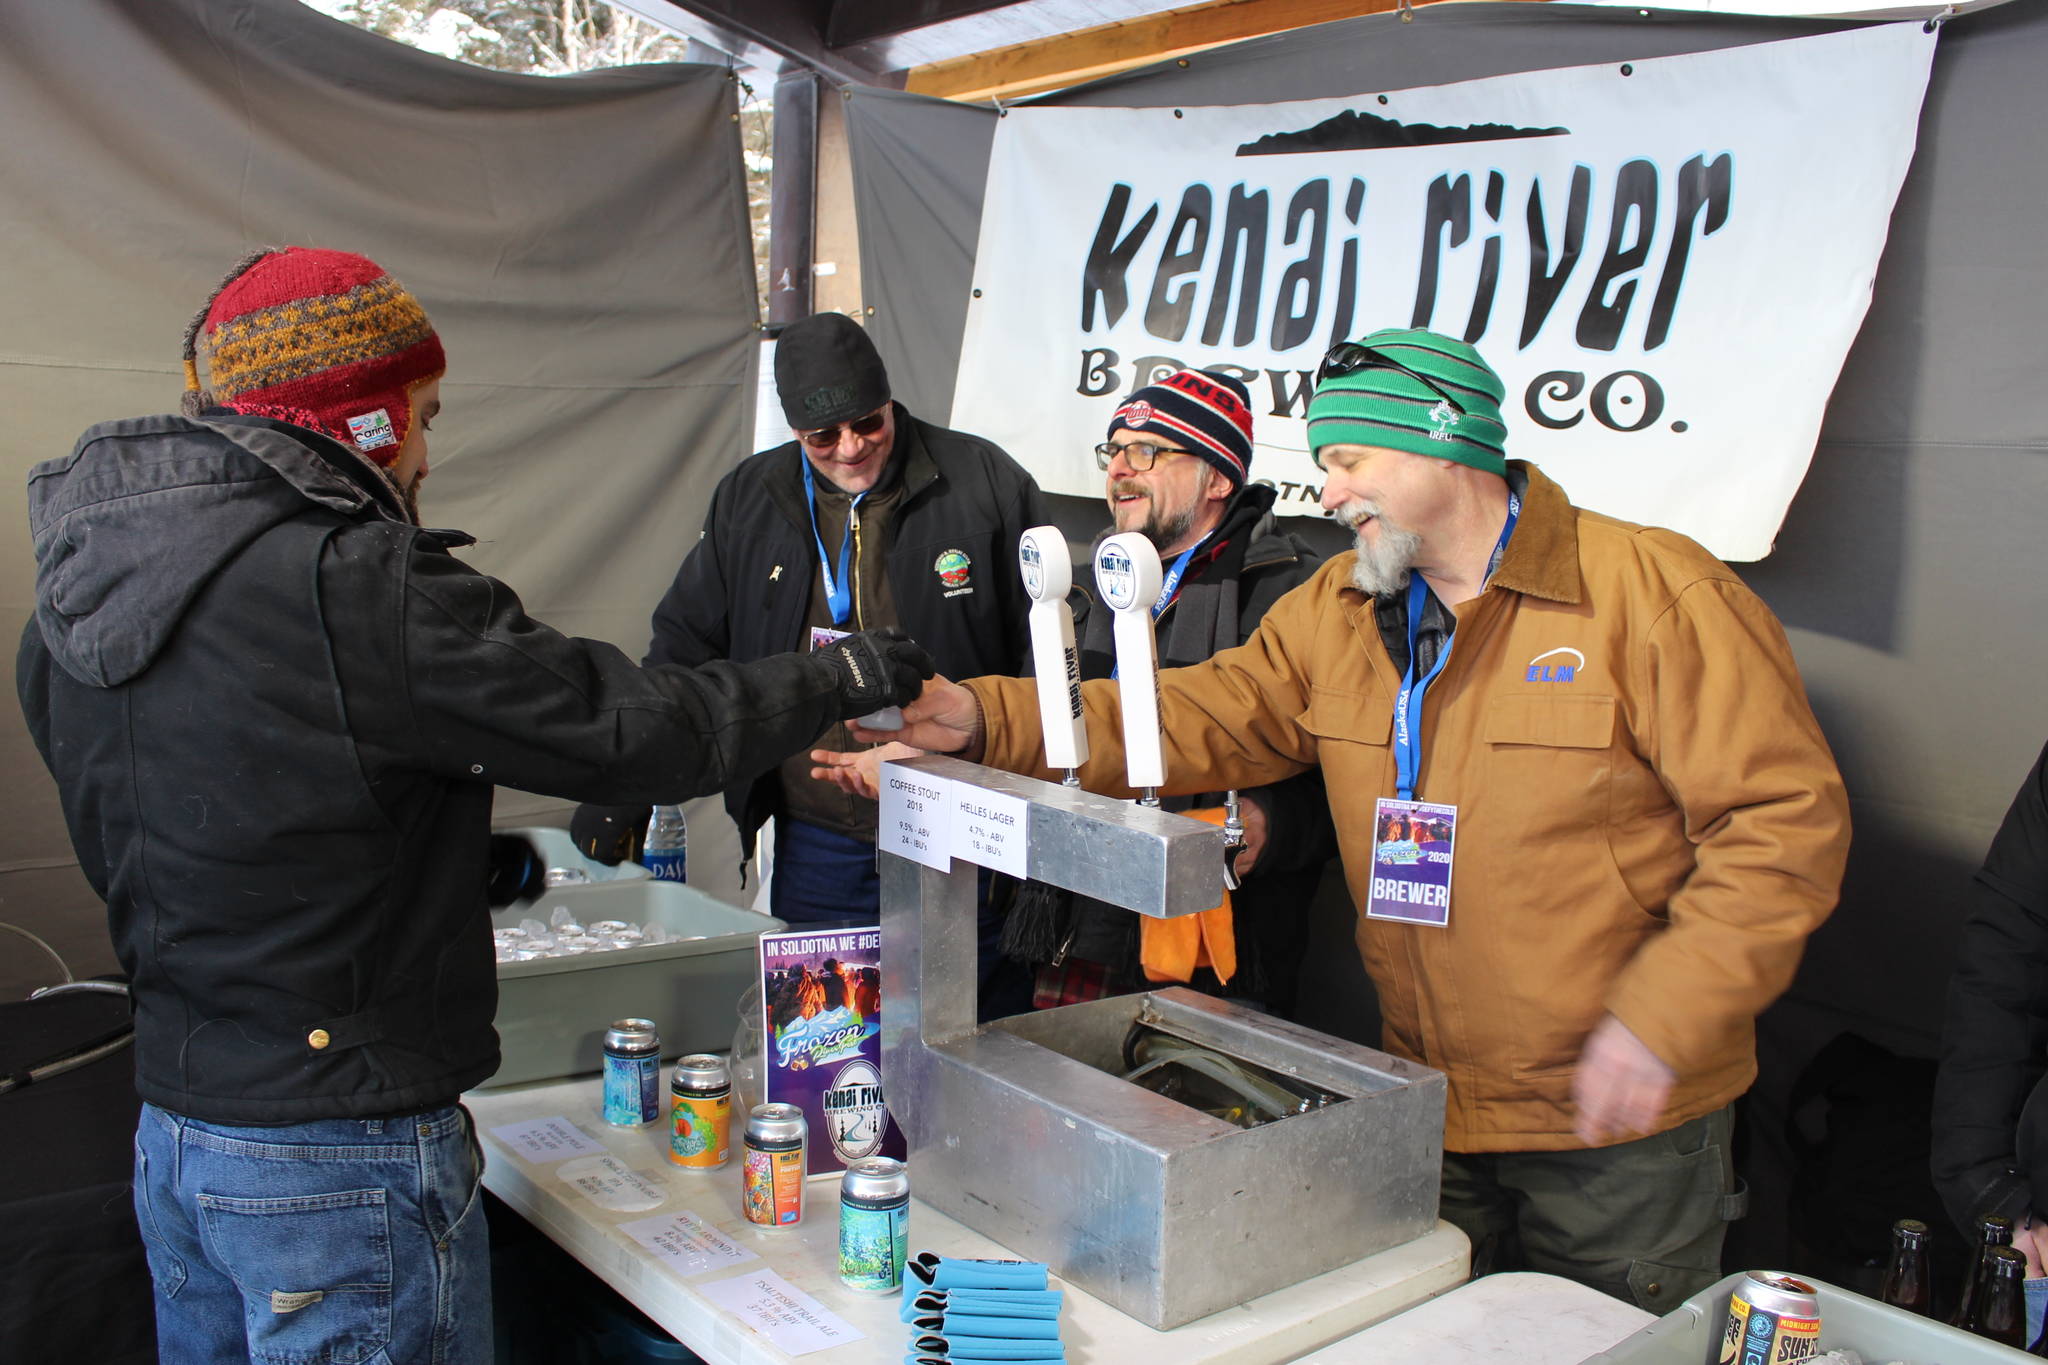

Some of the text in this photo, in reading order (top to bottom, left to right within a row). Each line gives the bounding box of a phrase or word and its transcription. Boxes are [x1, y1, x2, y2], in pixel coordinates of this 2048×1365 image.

[1409, 151, 1733, 351] river
[1523, 370, 1688, 433] CO.
[354, 423, 393, 444] Caring
[1429, 430, 1453, 441] IRFU
[846, 656, 865, 688] HUSKY
[1526, 665, 1575, 683] ELM
[1397, 690, 1410, 747] AlaskaUSA
[889, 778, 941, 801] COFFEE STOUT
[907, 799, 924, 813] 2018
[960, 801, 1015, 827] HELLES LAGER
[899, 821, 930, 838] 9.5% ABV
[968, 825, 1005, 844] 4.7% ABV
[901, 835, 928, 851] 24 IBU's
[972, 840, 1002, 857] 18 IBU's
[1428, 851, 1451, 864] 2020
[653, 859, 686, 880] DAS
[1373, 877, 1447, 907] BREWER
[767, 941, 779, 957] IN
[781, 937, 838, 956] SOLDOTNA
[839, 936, 856, 951] WE
[778, 1024, 865, 1068] Frozen
[825, 1105, 873, 1116] BREWING
[779, 1312, 801, 1325] ABV
[793, 1307, 821, 1326] TRAIL
[816, 1325, 840, 1337] ALE
